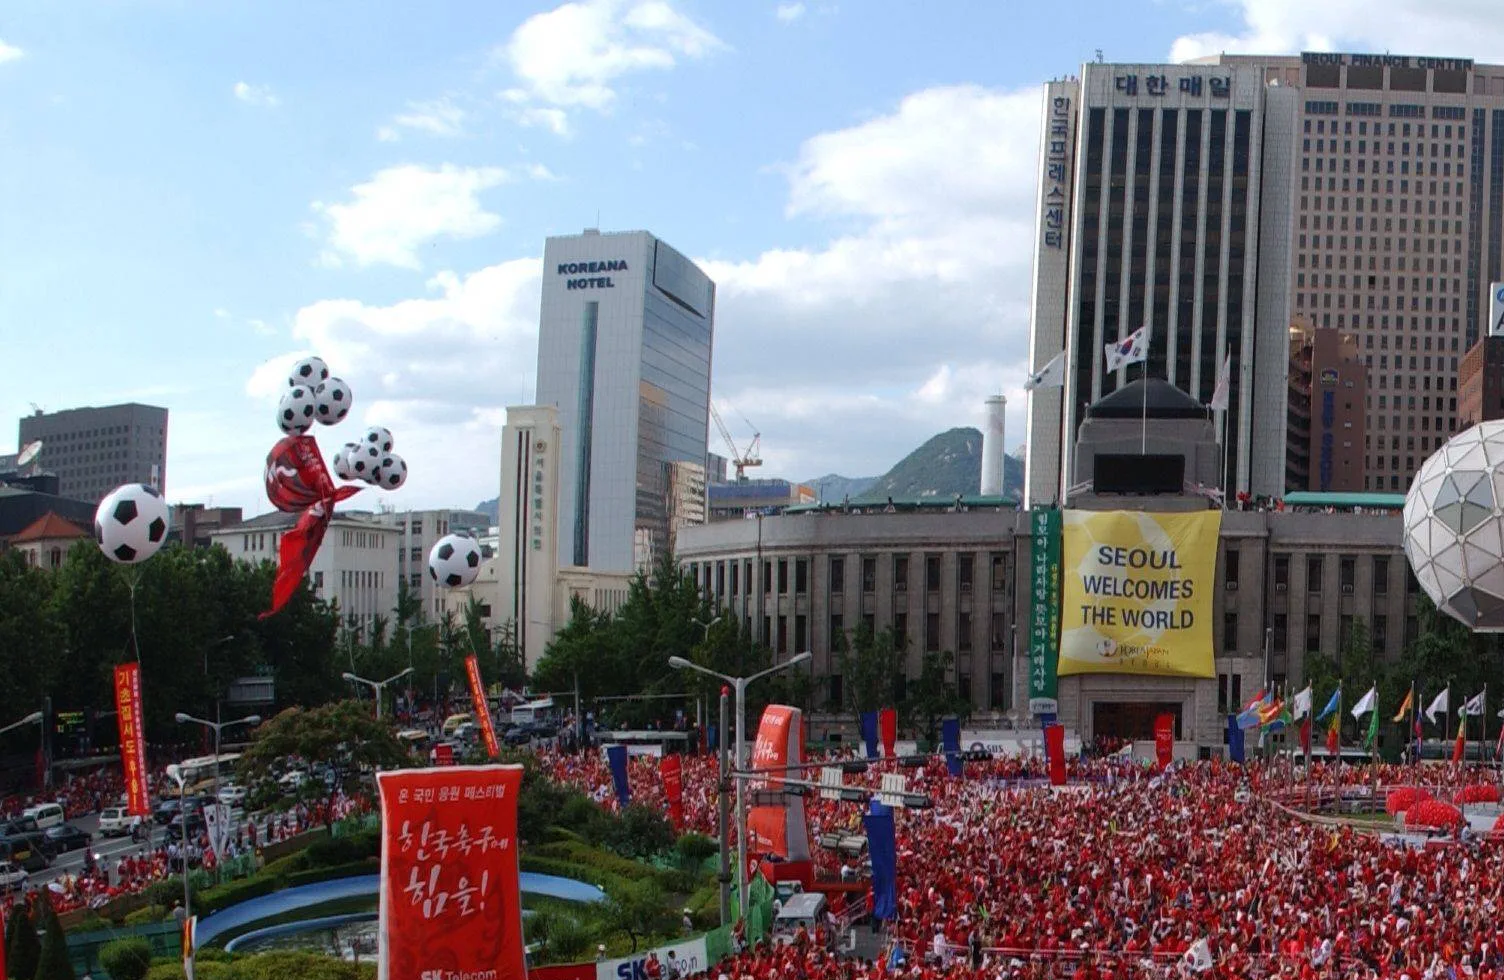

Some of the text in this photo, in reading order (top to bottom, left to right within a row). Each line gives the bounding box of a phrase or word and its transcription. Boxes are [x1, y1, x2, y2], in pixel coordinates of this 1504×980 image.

[1303, 53, 1473, 71] SEOUL FINANCE CENTER
[1115, 75, 1231, 96] 대한매일
[1045, 98, 1071, 250] 한국프레스센터
[557, 260, 628, 275] KOREANA
[567, 277, 614, 290] HOTEL
[1098, 546, 1182, 569] SEOUL
[1083, 575, 1193, 599] WELCOMES
[1081, 606, 1194, 629] THE WORLD
[398, 784, 505, 803] 온 국민 응원 페스티벌
[404, 864, 488, 918] 힘을!
